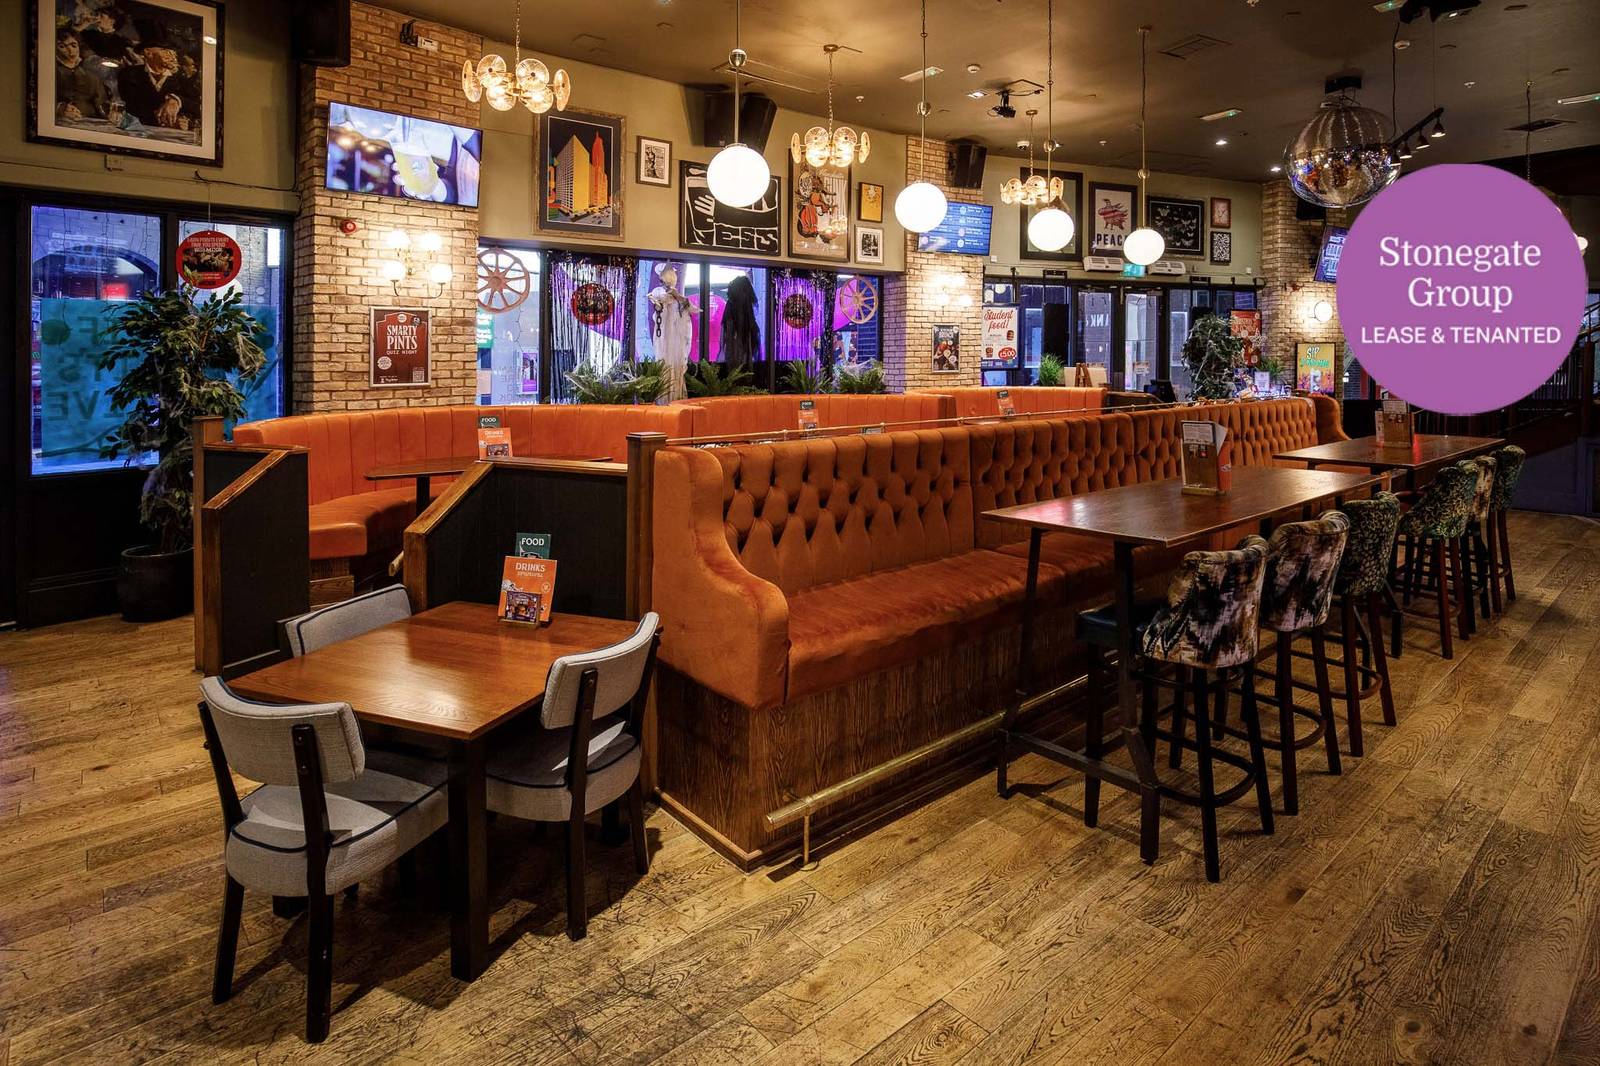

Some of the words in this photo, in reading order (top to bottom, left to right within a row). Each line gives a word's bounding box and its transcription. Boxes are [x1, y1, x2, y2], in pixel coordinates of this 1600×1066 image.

[1096, 233, 1128, 247] PEAC
[984, 310, 1014, 321] Student
[387, 325, 417, 336] SMARTY
[387, 336, 418, 350] PINTS
[521, 537, 545, 546] FOOD
[515, 562, 546, 573] DRINKS
